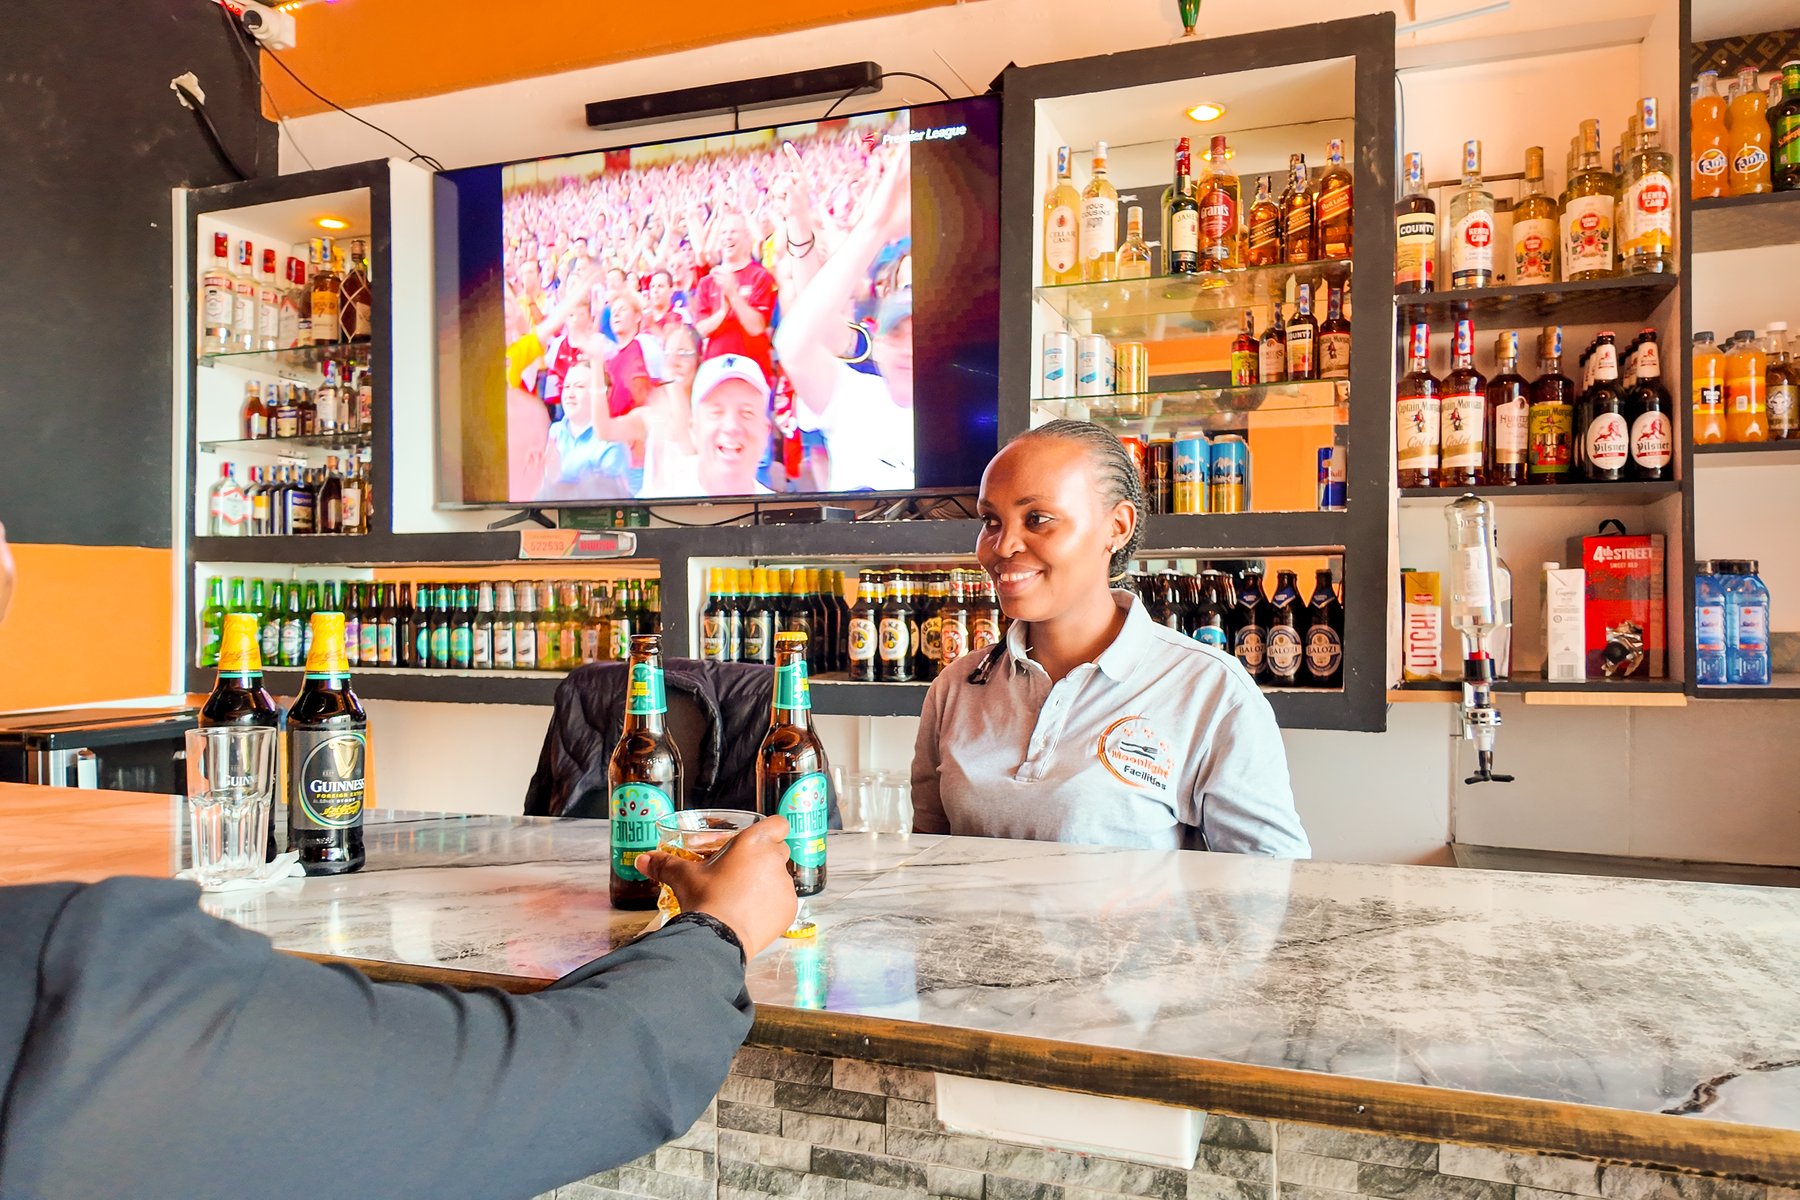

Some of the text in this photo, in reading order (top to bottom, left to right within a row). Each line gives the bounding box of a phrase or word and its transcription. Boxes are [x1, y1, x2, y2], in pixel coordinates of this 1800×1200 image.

[882, 125, 968, 145] Premier League
[1698, 156, 1728, 173] Fant
[1734, 152, 1768, 172] Fanta
[1641, 191, 1667, 199] KENYA
[1644, 199, 1665, 208] CANE
[1400, 224, 1434, 235] COUNTY
[1407, 436, 1434, 448] Gold
[1446, 434, 1472, 447] Gold
[1593, 443, 1626, 454] Pilsner
[1637, 441, 1670, 453] Pilsner
[1613, 547, 1653, 560] STREET
[1409, 613, 1437, 667] LITCHI
[1239, 645, 1264, 653] BALOZ
[1307, 646, 1337, 654] BALOZI
[1111, 750, 1169, 780] Moonlight
[1124, 765, 1167, 790] Facilities
